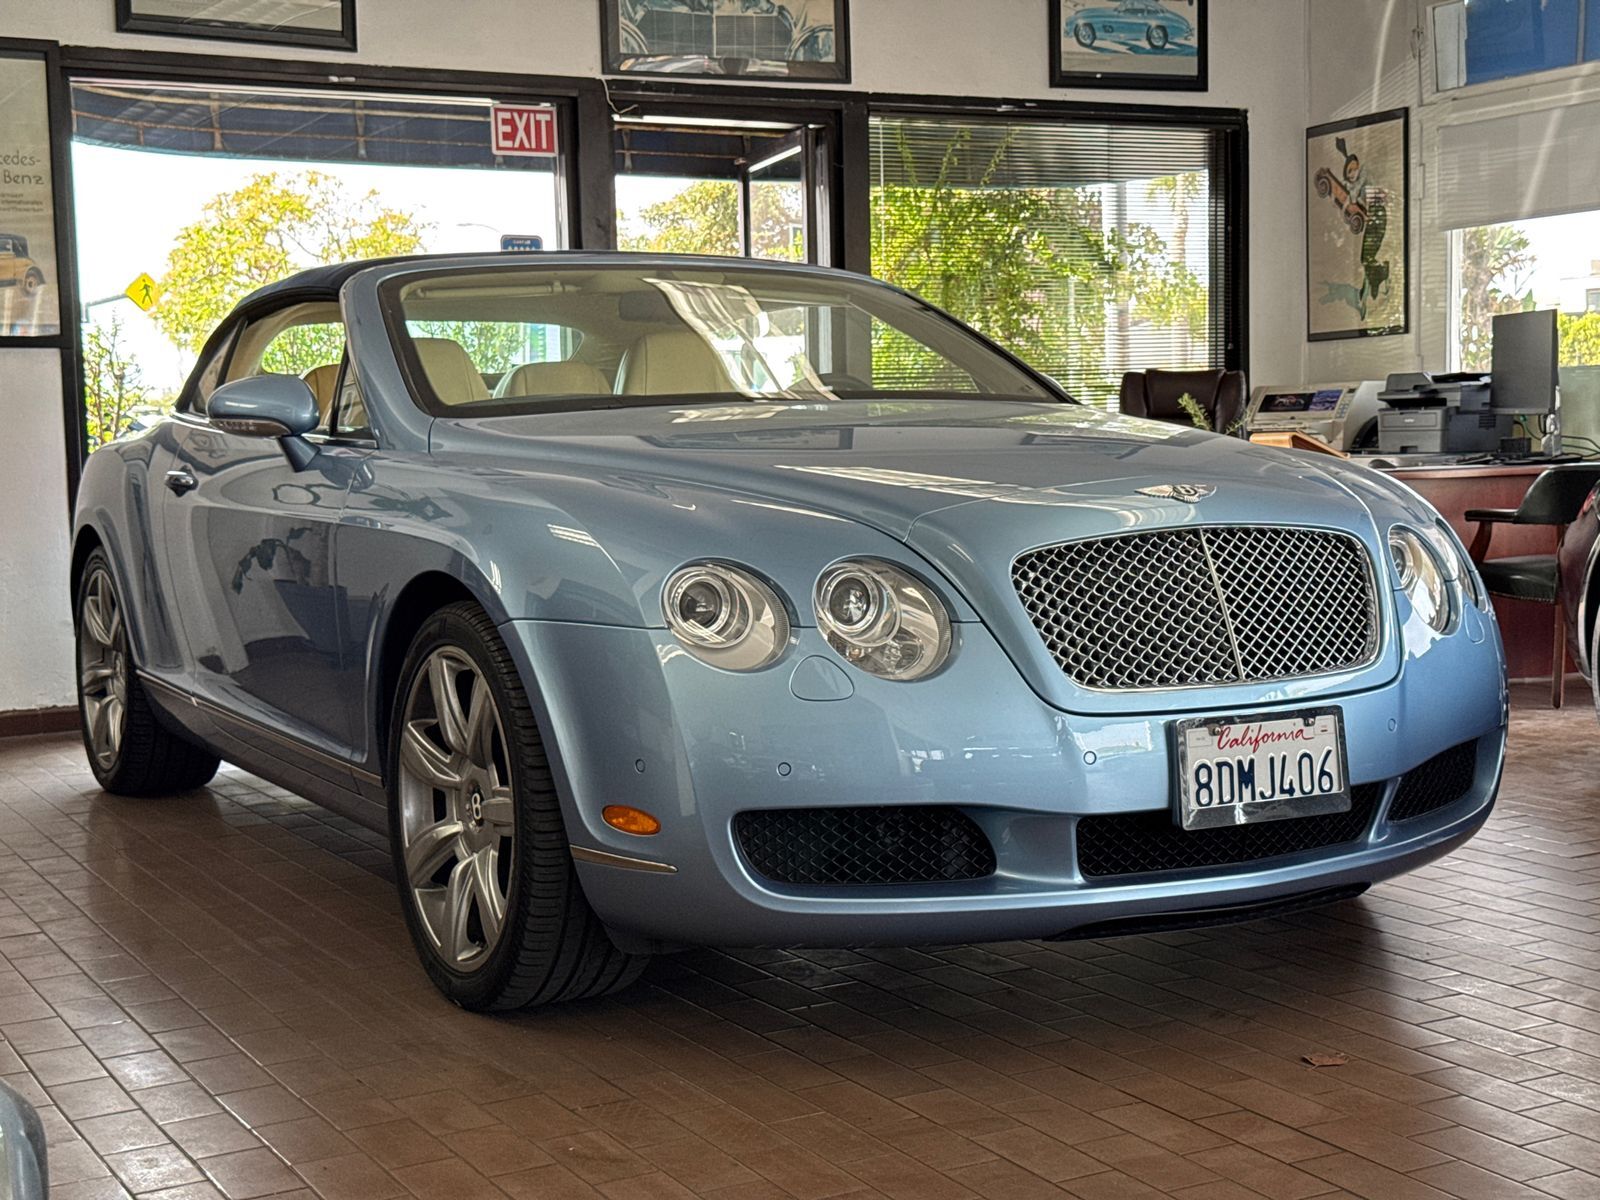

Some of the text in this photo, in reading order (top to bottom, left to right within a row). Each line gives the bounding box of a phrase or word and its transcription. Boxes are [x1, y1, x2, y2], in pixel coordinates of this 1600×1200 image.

[496, 111, 551, 149] EXIT
[3, 169, 44, 185] Benz
[1217, 724, 1314, 753] California
[1193, 747, 1334, 807] 8DMJ406
